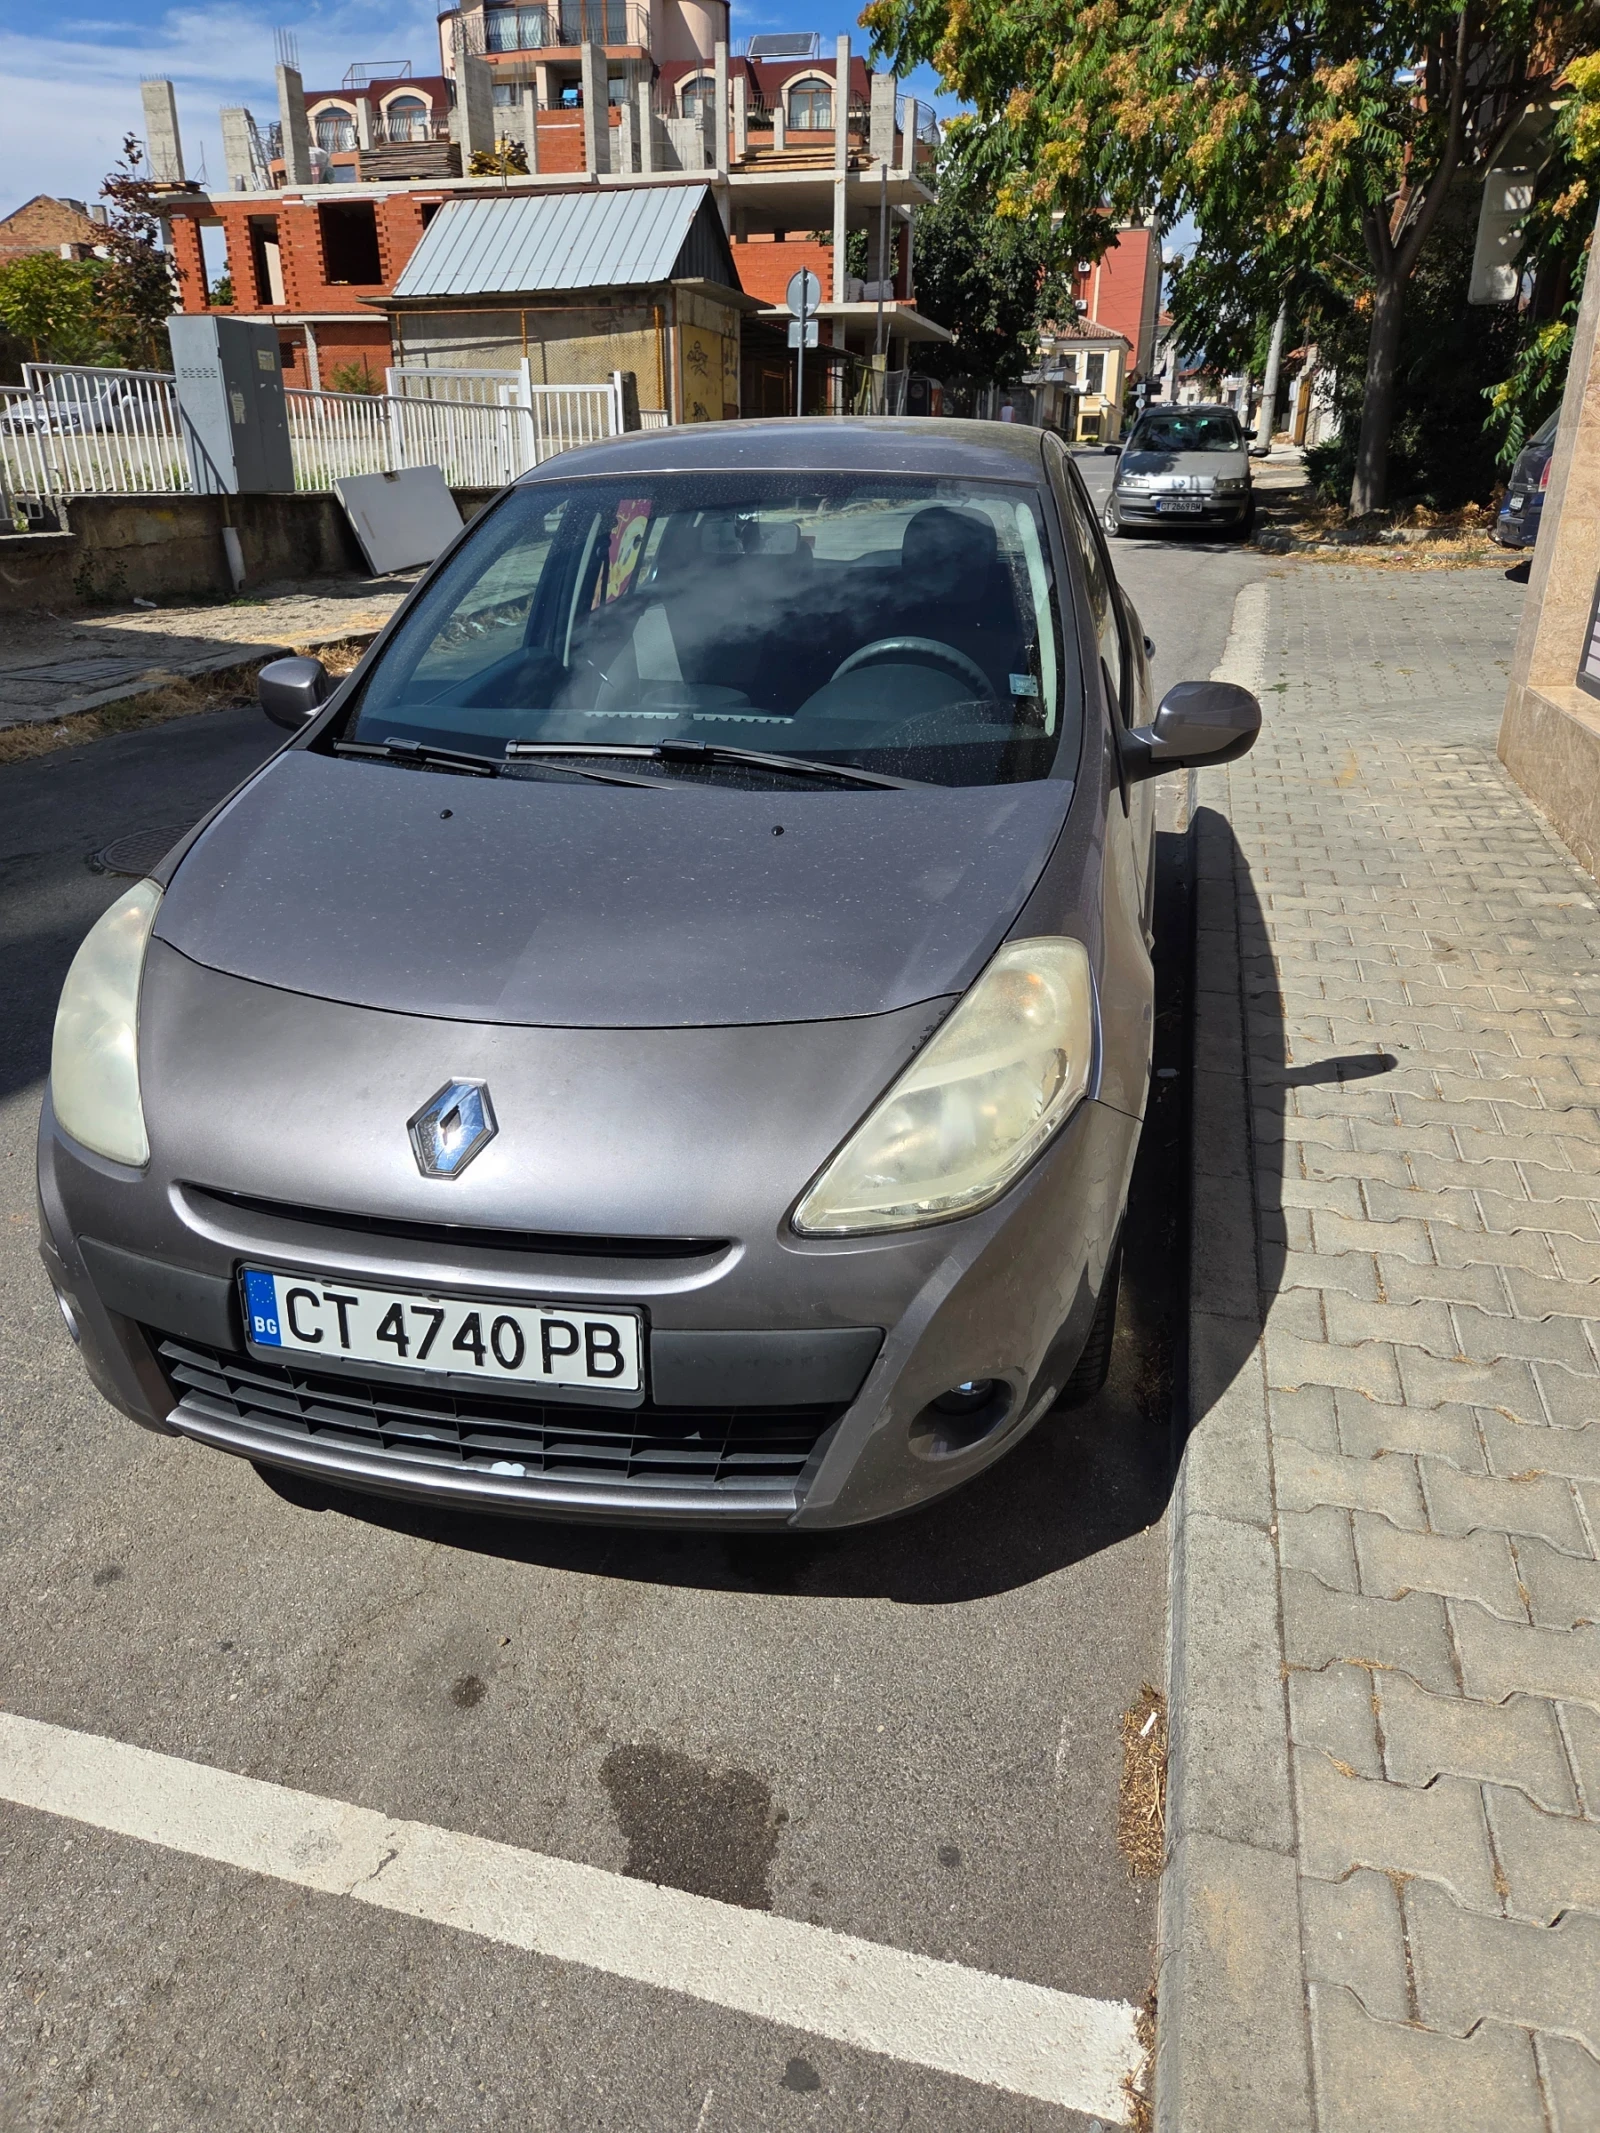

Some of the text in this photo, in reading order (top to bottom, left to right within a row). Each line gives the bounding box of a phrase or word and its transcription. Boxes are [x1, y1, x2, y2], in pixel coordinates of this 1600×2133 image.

[1161, 502, 1171, 510] CT
[253, 1315, 278, 1335] BG
[285, 1287, 626, 1379] CT 4740 PB
